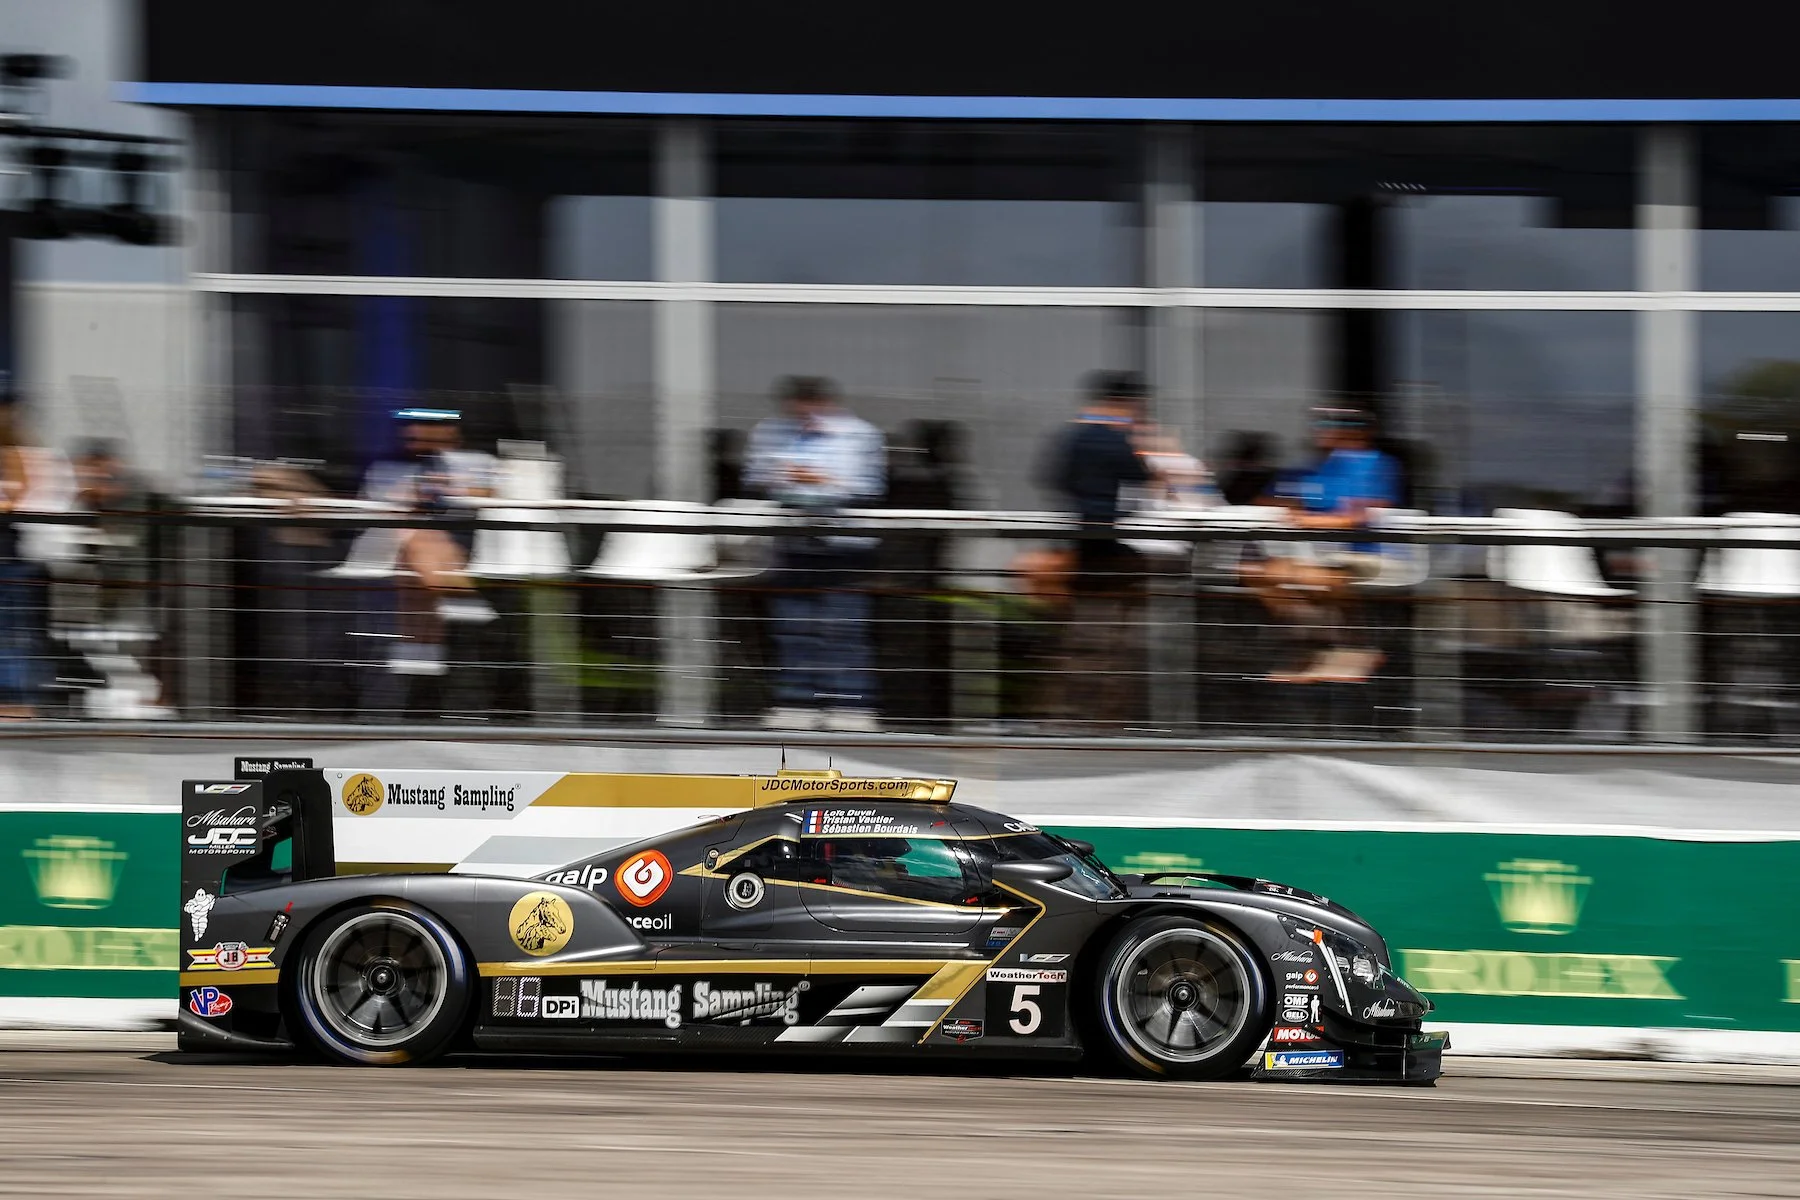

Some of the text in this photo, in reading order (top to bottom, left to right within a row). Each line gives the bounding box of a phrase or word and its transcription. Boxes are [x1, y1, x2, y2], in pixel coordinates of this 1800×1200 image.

[241, 761, 271, 774] Mustang
[761, 779, 909, 792] JDCMotorSports.com
[387, 783, 446, 810] Mustang
[847, 809, 876, 817] Duval
[822, 816, 894, 825] Tristan Vautier
[821, 824, 918, 834] Sébastien Bourdais
[187, 828, 257, 845] JDC
[1286, 972, 1303, 980] galp
[190, 987, 219, 1016] VP
[546, 1000, 576, 1014] DPi
[580, 980, 682, 1029] Mustang
[1284, 996, 1308, 1006] OMP
[1009, 985, 1041, 1035] 5
[1288, 1056, 1338, 1064] MICHELIN
